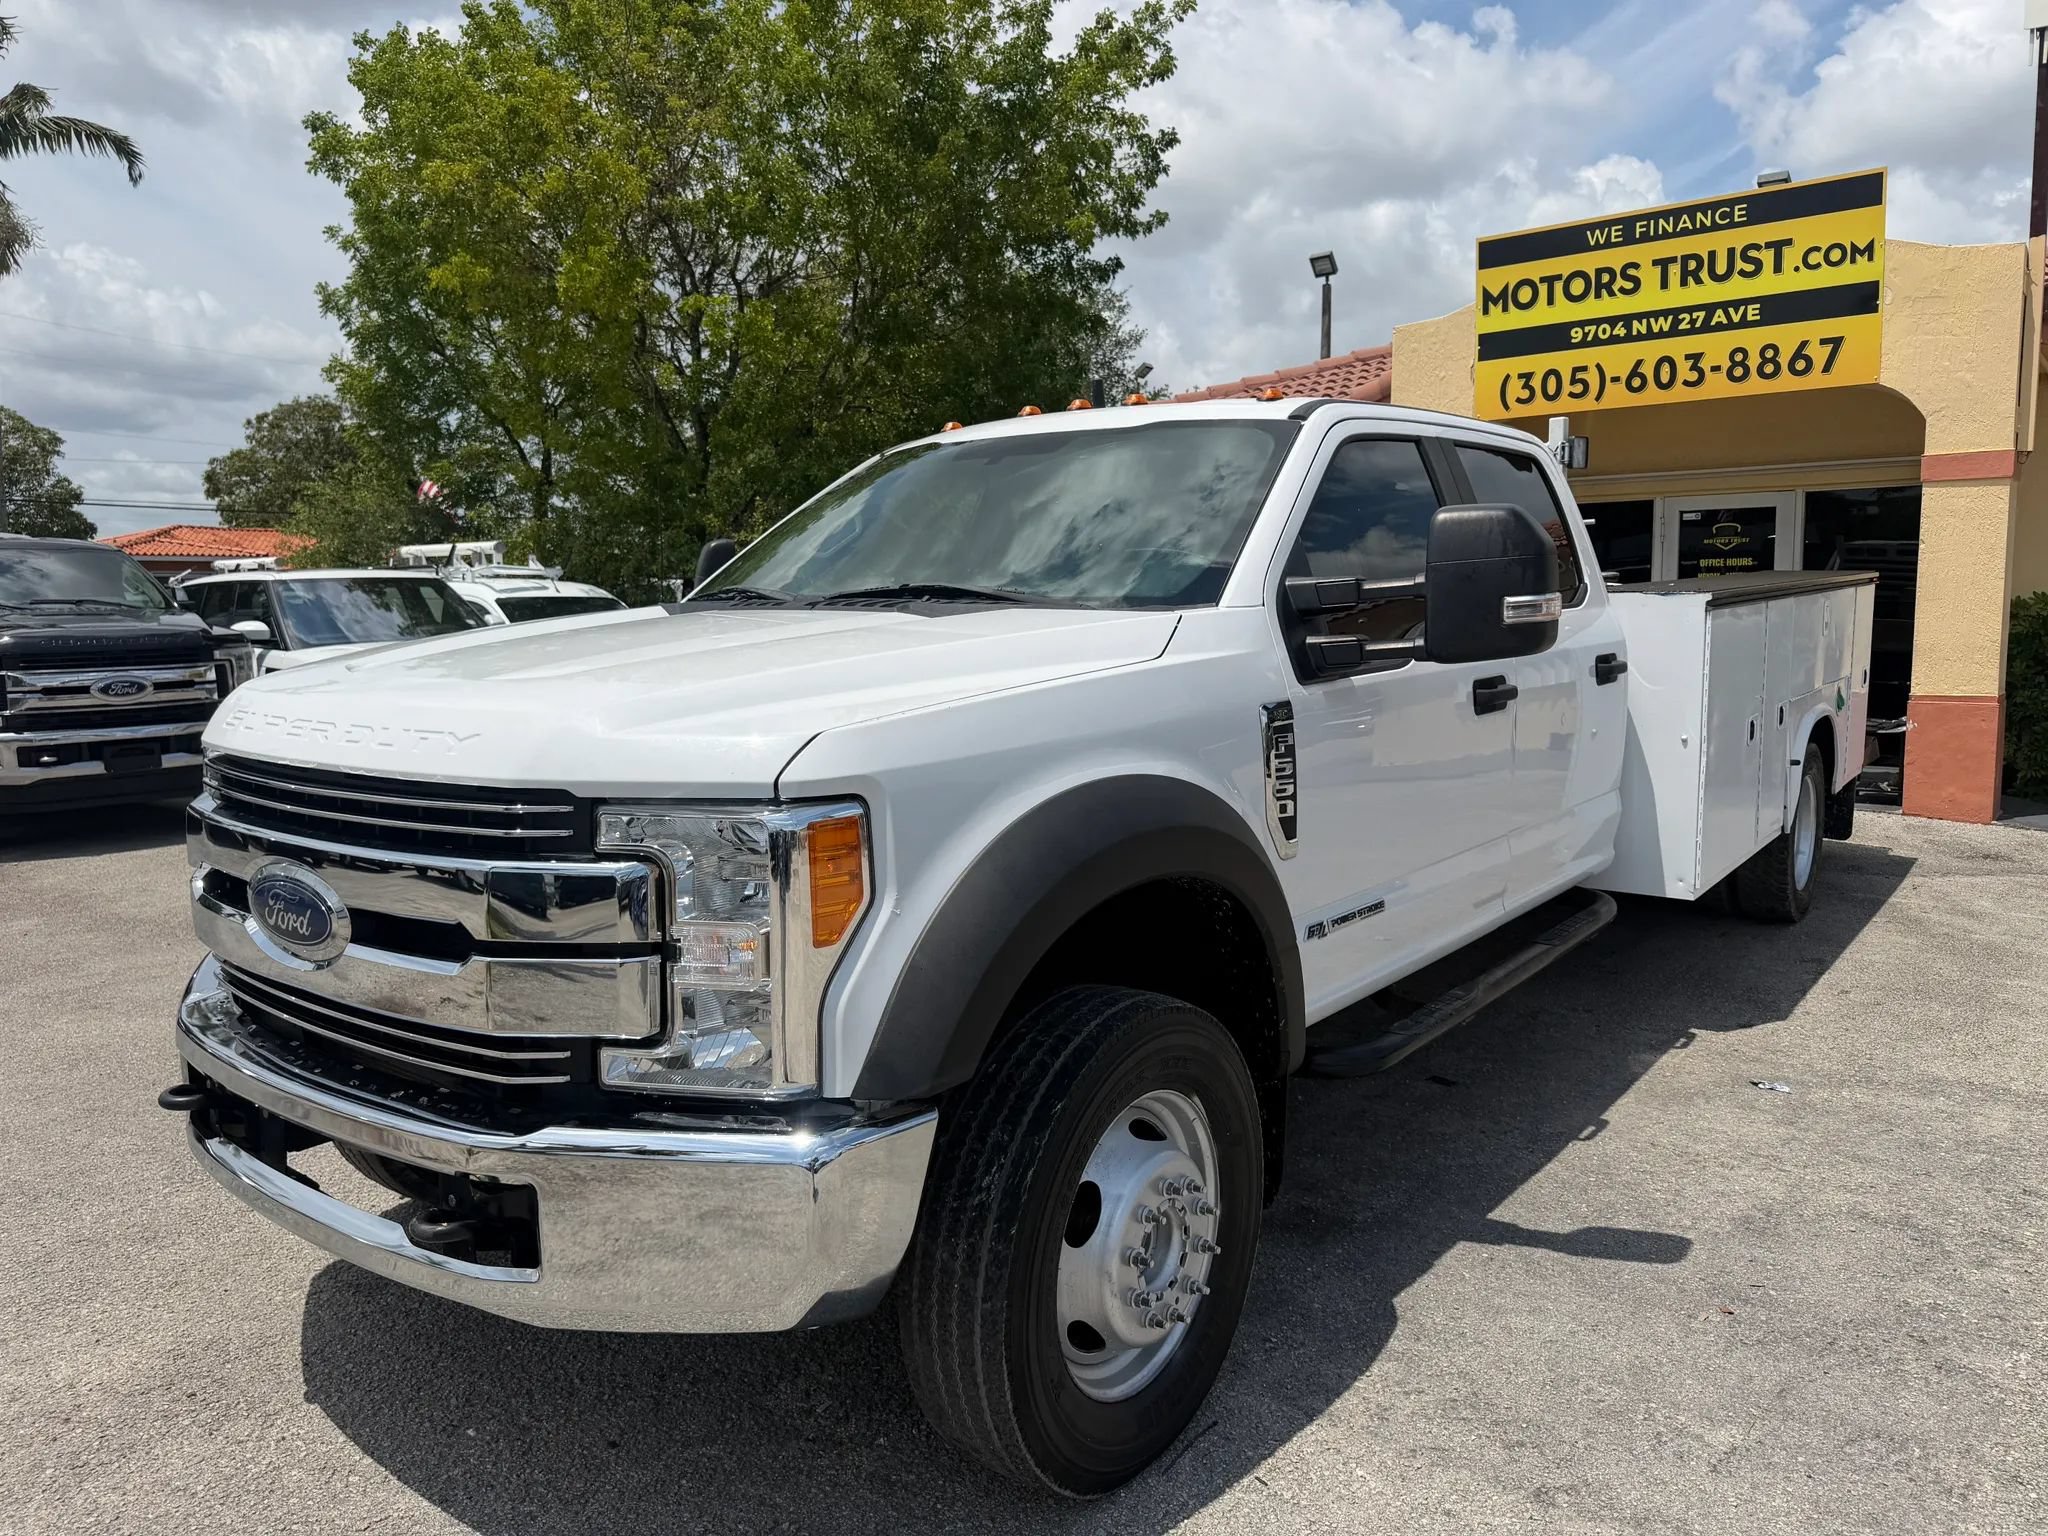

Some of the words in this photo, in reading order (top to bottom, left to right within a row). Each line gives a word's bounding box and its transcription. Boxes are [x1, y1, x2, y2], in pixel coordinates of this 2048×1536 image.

[1586, 224, 1624, 247] WE
[1634, 203, 1748, 239] FINANCE
[1481, 261, 1642, 317] MOTORS
[1569, 321, 1628, 344] 9704
[1631, 314, 1675, 336] NW
[1678, 311, 1705, 331] 27
[1709, 303, 1762, 326] AVE
[1498, 335, 1847, 412] (305)-603-8867
[1700, 558, 1725, 567] OFFICE
[1726, 557, 1753, 566] HOURS
[108, 683, 138, 696] Ford
[223, 707, 338, 744] SUPER
[336, 722, 482, 758] DUTY
[264, 888, 312, 936] Ford
